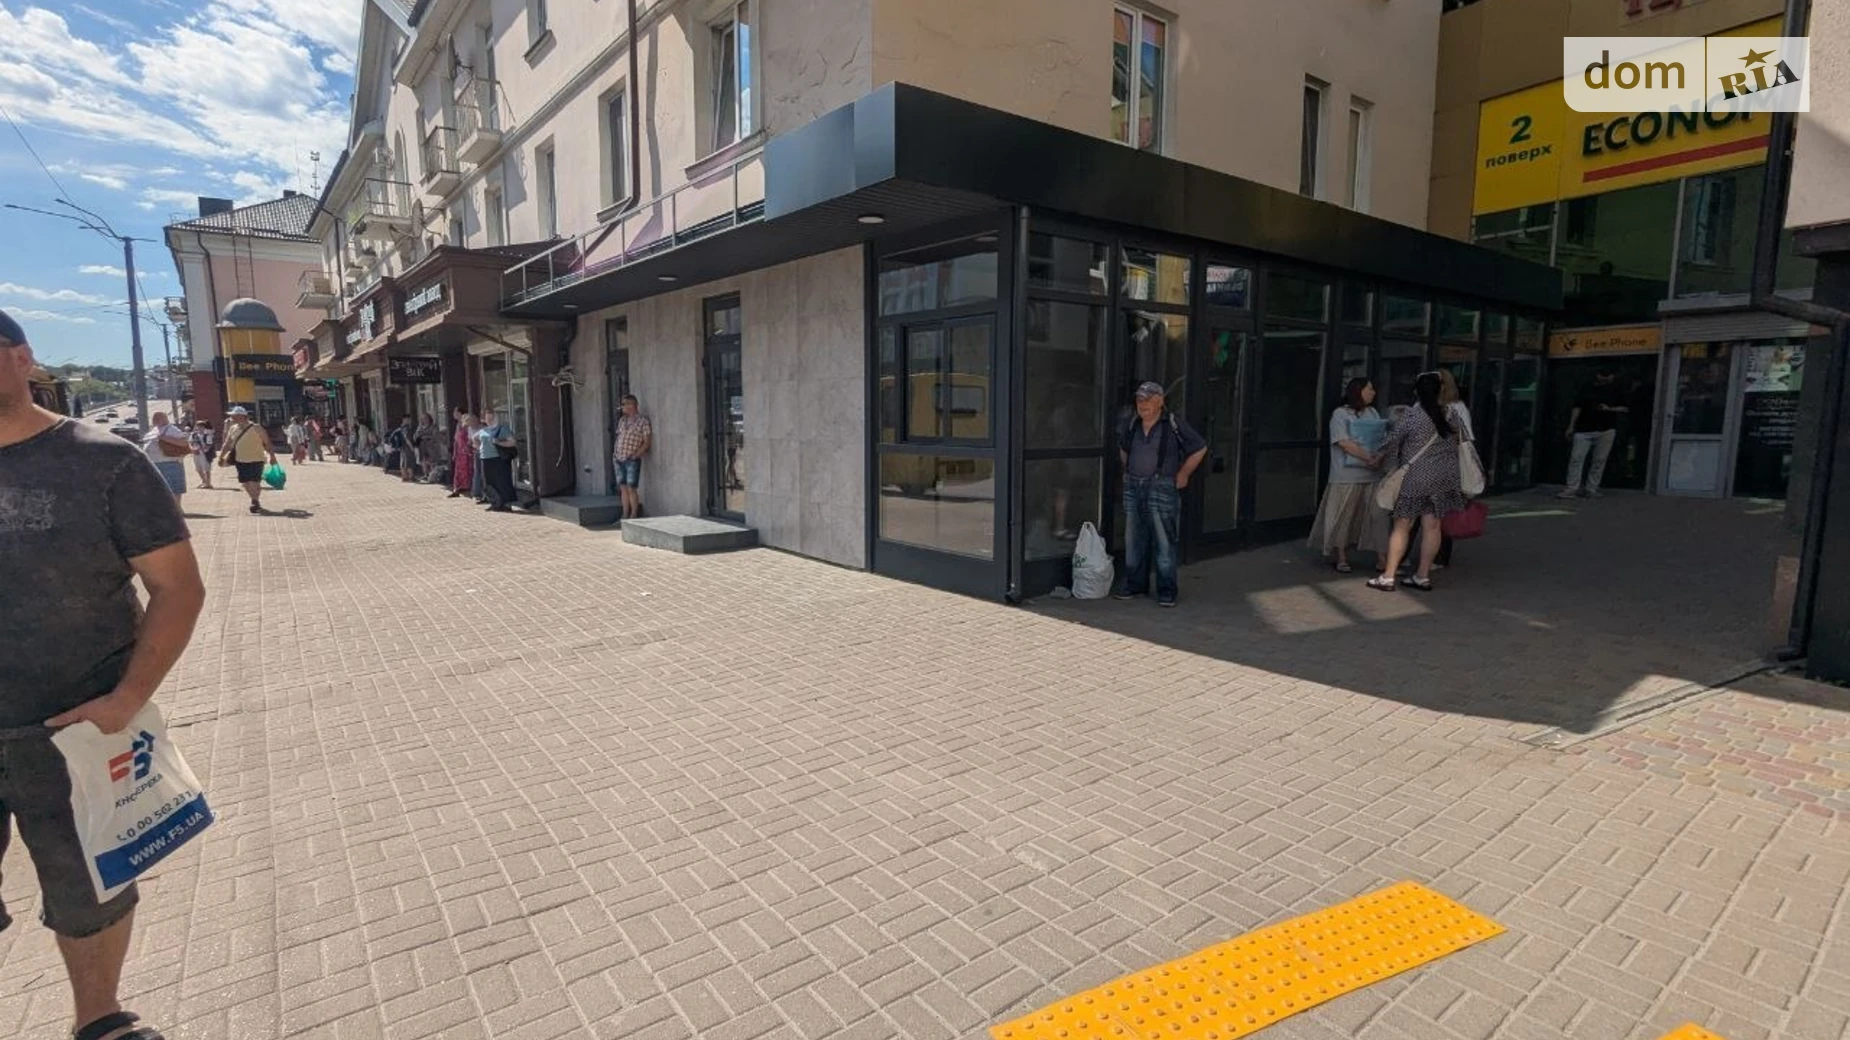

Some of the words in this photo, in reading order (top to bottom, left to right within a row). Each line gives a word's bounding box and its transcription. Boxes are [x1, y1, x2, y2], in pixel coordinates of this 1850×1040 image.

[1509, 115, 1532, 144] 2
[1485, 143, 1552, 169] поверх
[1610, 337, 1647, 348] Phone
[128, 812, 204, 866] WWW.F5.UA
